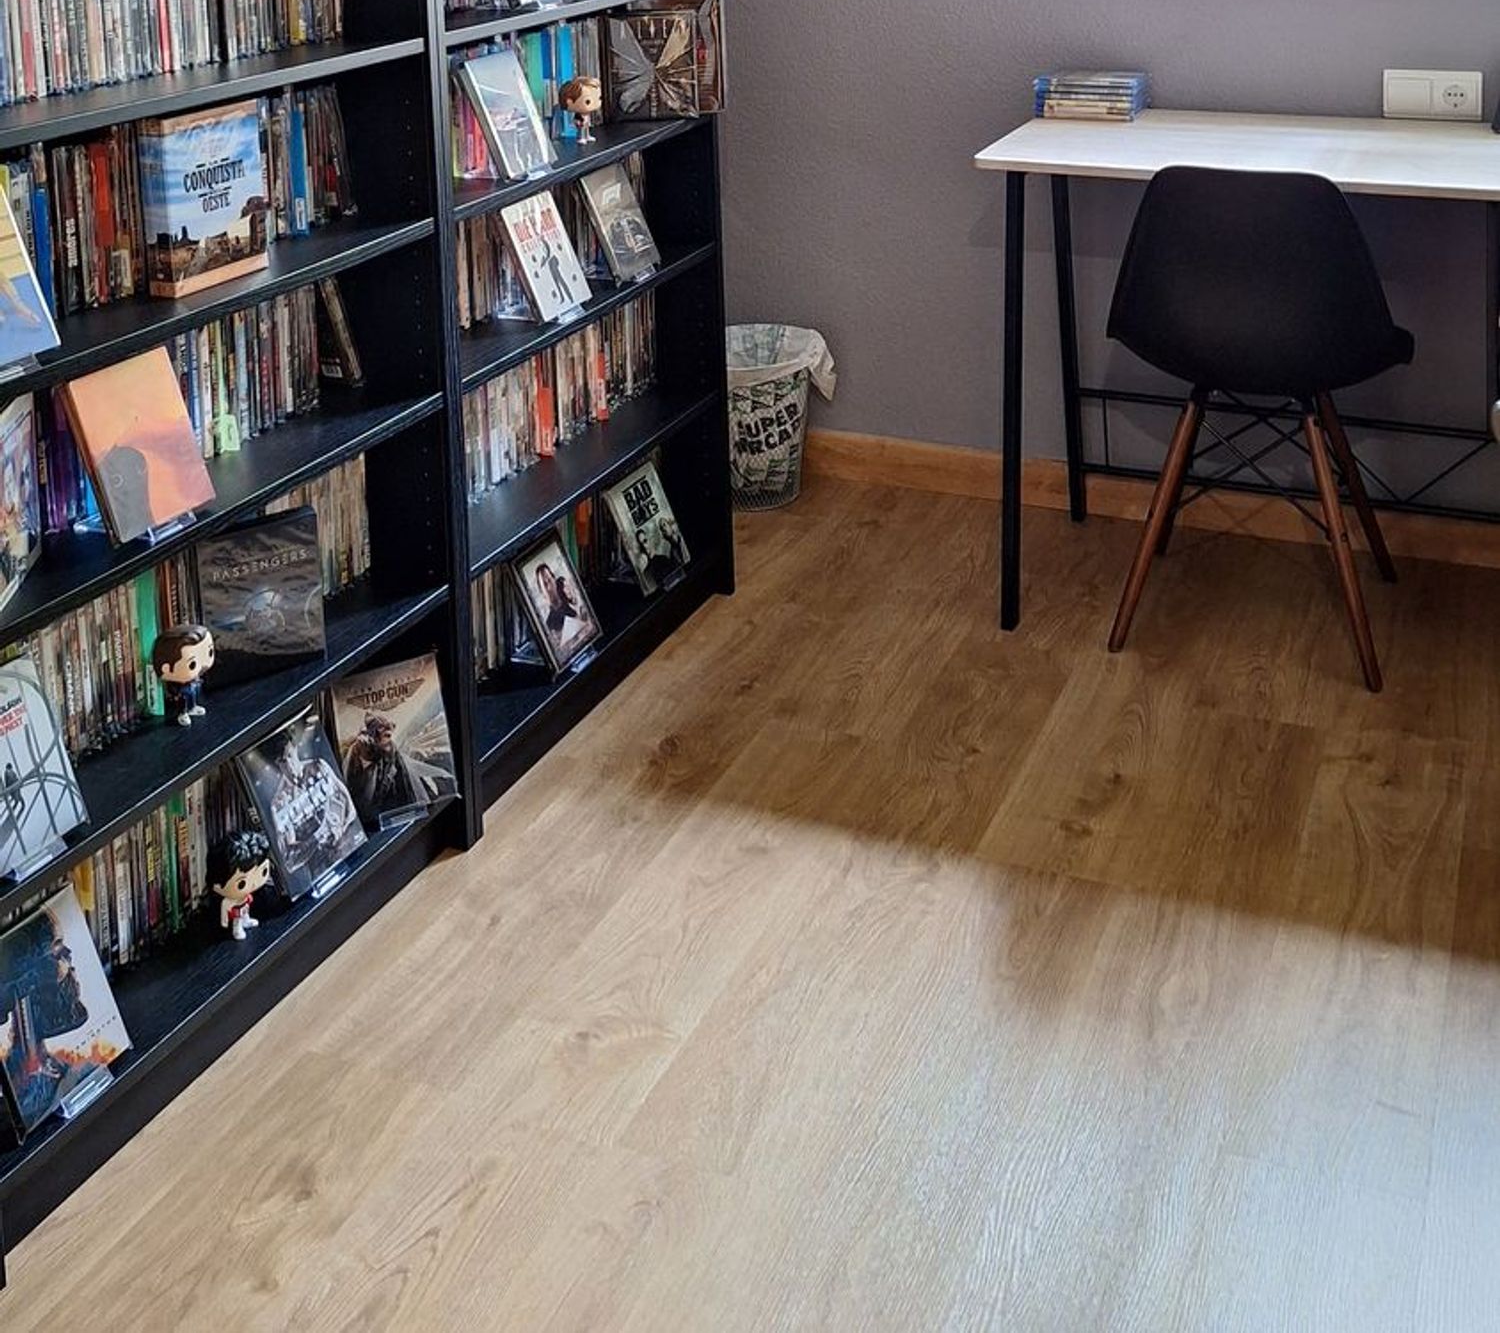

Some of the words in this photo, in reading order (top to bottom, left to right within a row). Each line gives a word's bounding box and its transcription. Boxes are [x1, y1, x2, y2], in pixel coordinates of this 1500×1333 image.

[183, 159, 246, 194] CONQUISTA
[202, 191, 232, 214] OESTE
[623, 479, 654, 513] BAD
[213, 548, 308, 582] PASSENGERS
[363, 688, 386, 705] TOP
[386, 681, 410, 701] GUN
